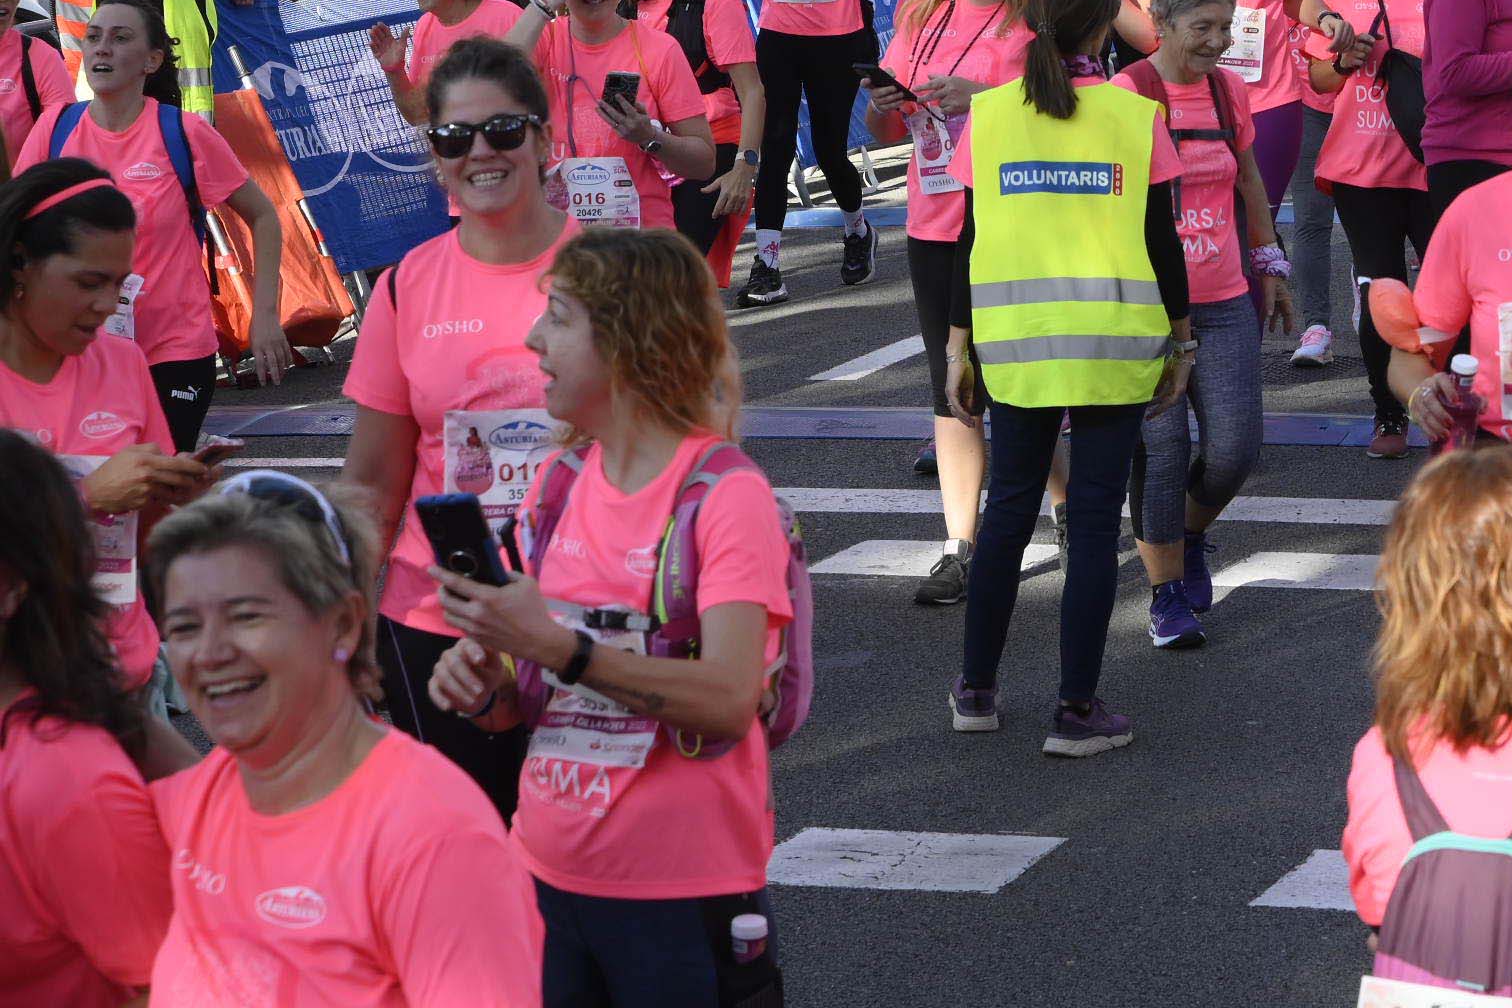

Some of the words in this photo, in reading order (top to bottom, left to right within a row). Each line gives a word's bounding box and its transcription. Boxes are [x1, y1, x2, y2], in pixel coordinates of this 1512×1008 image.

[928, 179, 955, 188] OYSHO
[1001, 169, 1109, 187] VOLUNTARIS
[573, 192, 606, 205] 016
[1183, 233, 1220, 256] MA
[423, 319, 483, 339] OYSHO
